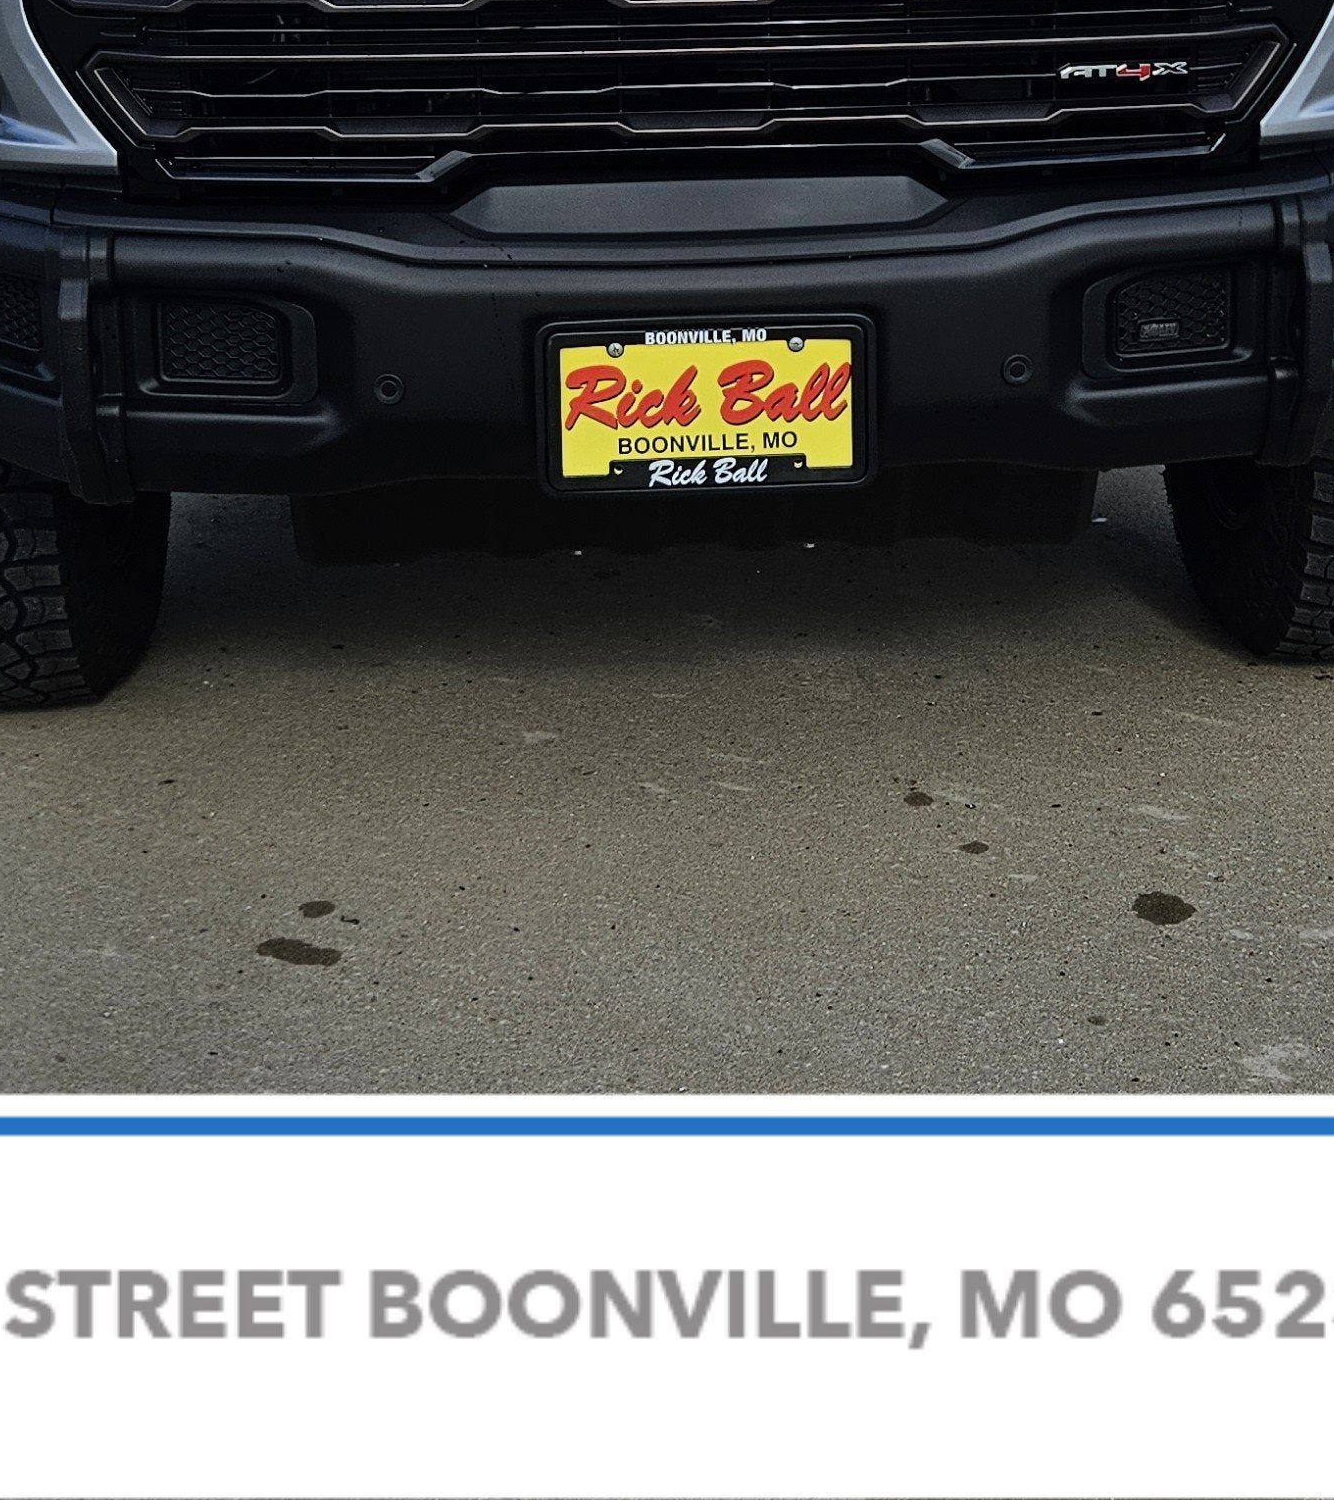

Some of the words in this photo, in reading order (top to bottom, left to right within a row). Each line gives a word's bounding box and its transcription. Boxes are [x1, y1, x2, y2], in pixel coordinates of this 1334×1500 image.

[1058, 61, 1189, 82] AT4X
[644, 329, 737, 346] BOONVILLE,
[742, 328, 767, 342] MO
[565, 364, 701, 430] Rick
[718, 360, 852, 425] Ball
[617, 433, 756, 455] BOONVILLE,
[762, 431, 798, 449] MO
[648, 463, 707, 488] Rick
[712, 458, 768, 485] Ball
